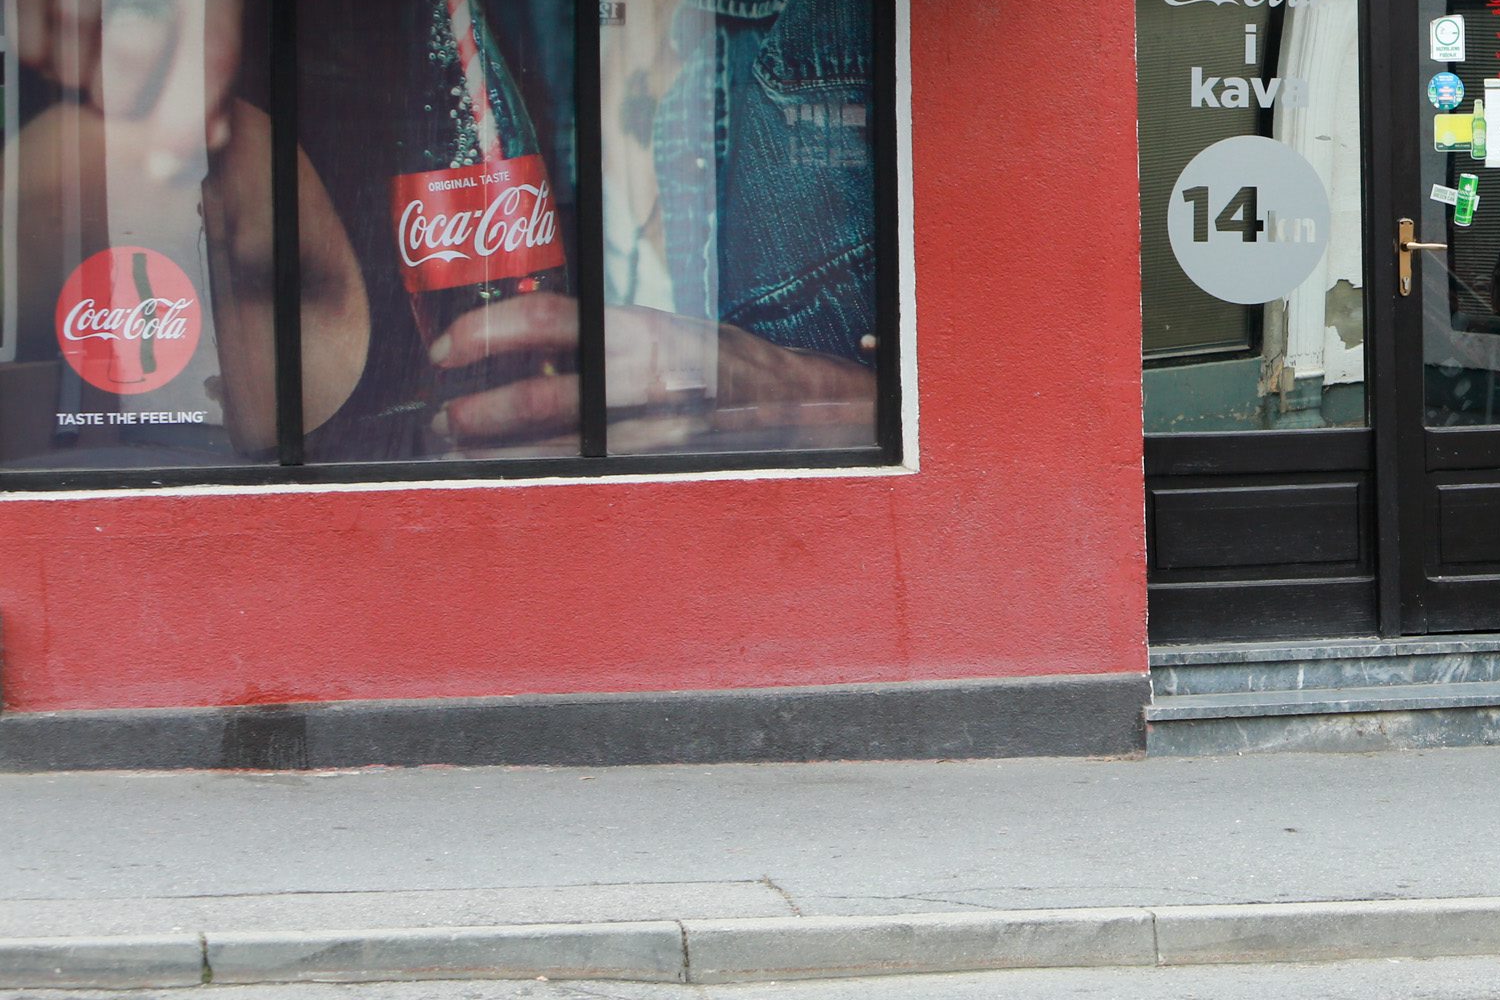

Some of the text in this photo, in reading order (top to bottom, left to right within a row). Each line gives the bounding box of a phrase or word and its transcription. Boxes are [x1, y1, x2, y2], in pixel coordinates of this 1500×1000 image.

[1244, 23, 1257, 65] i
[1191, 66, 1310, 109] kava
[428, 171, 511, 192] ORIGINAL TASTE
[398, 179, 556, 267] Coca-Cola
[63, 298, 194, 341] Coca-Cola
[56, 411, 204, 425] TASTE THE FEELING
